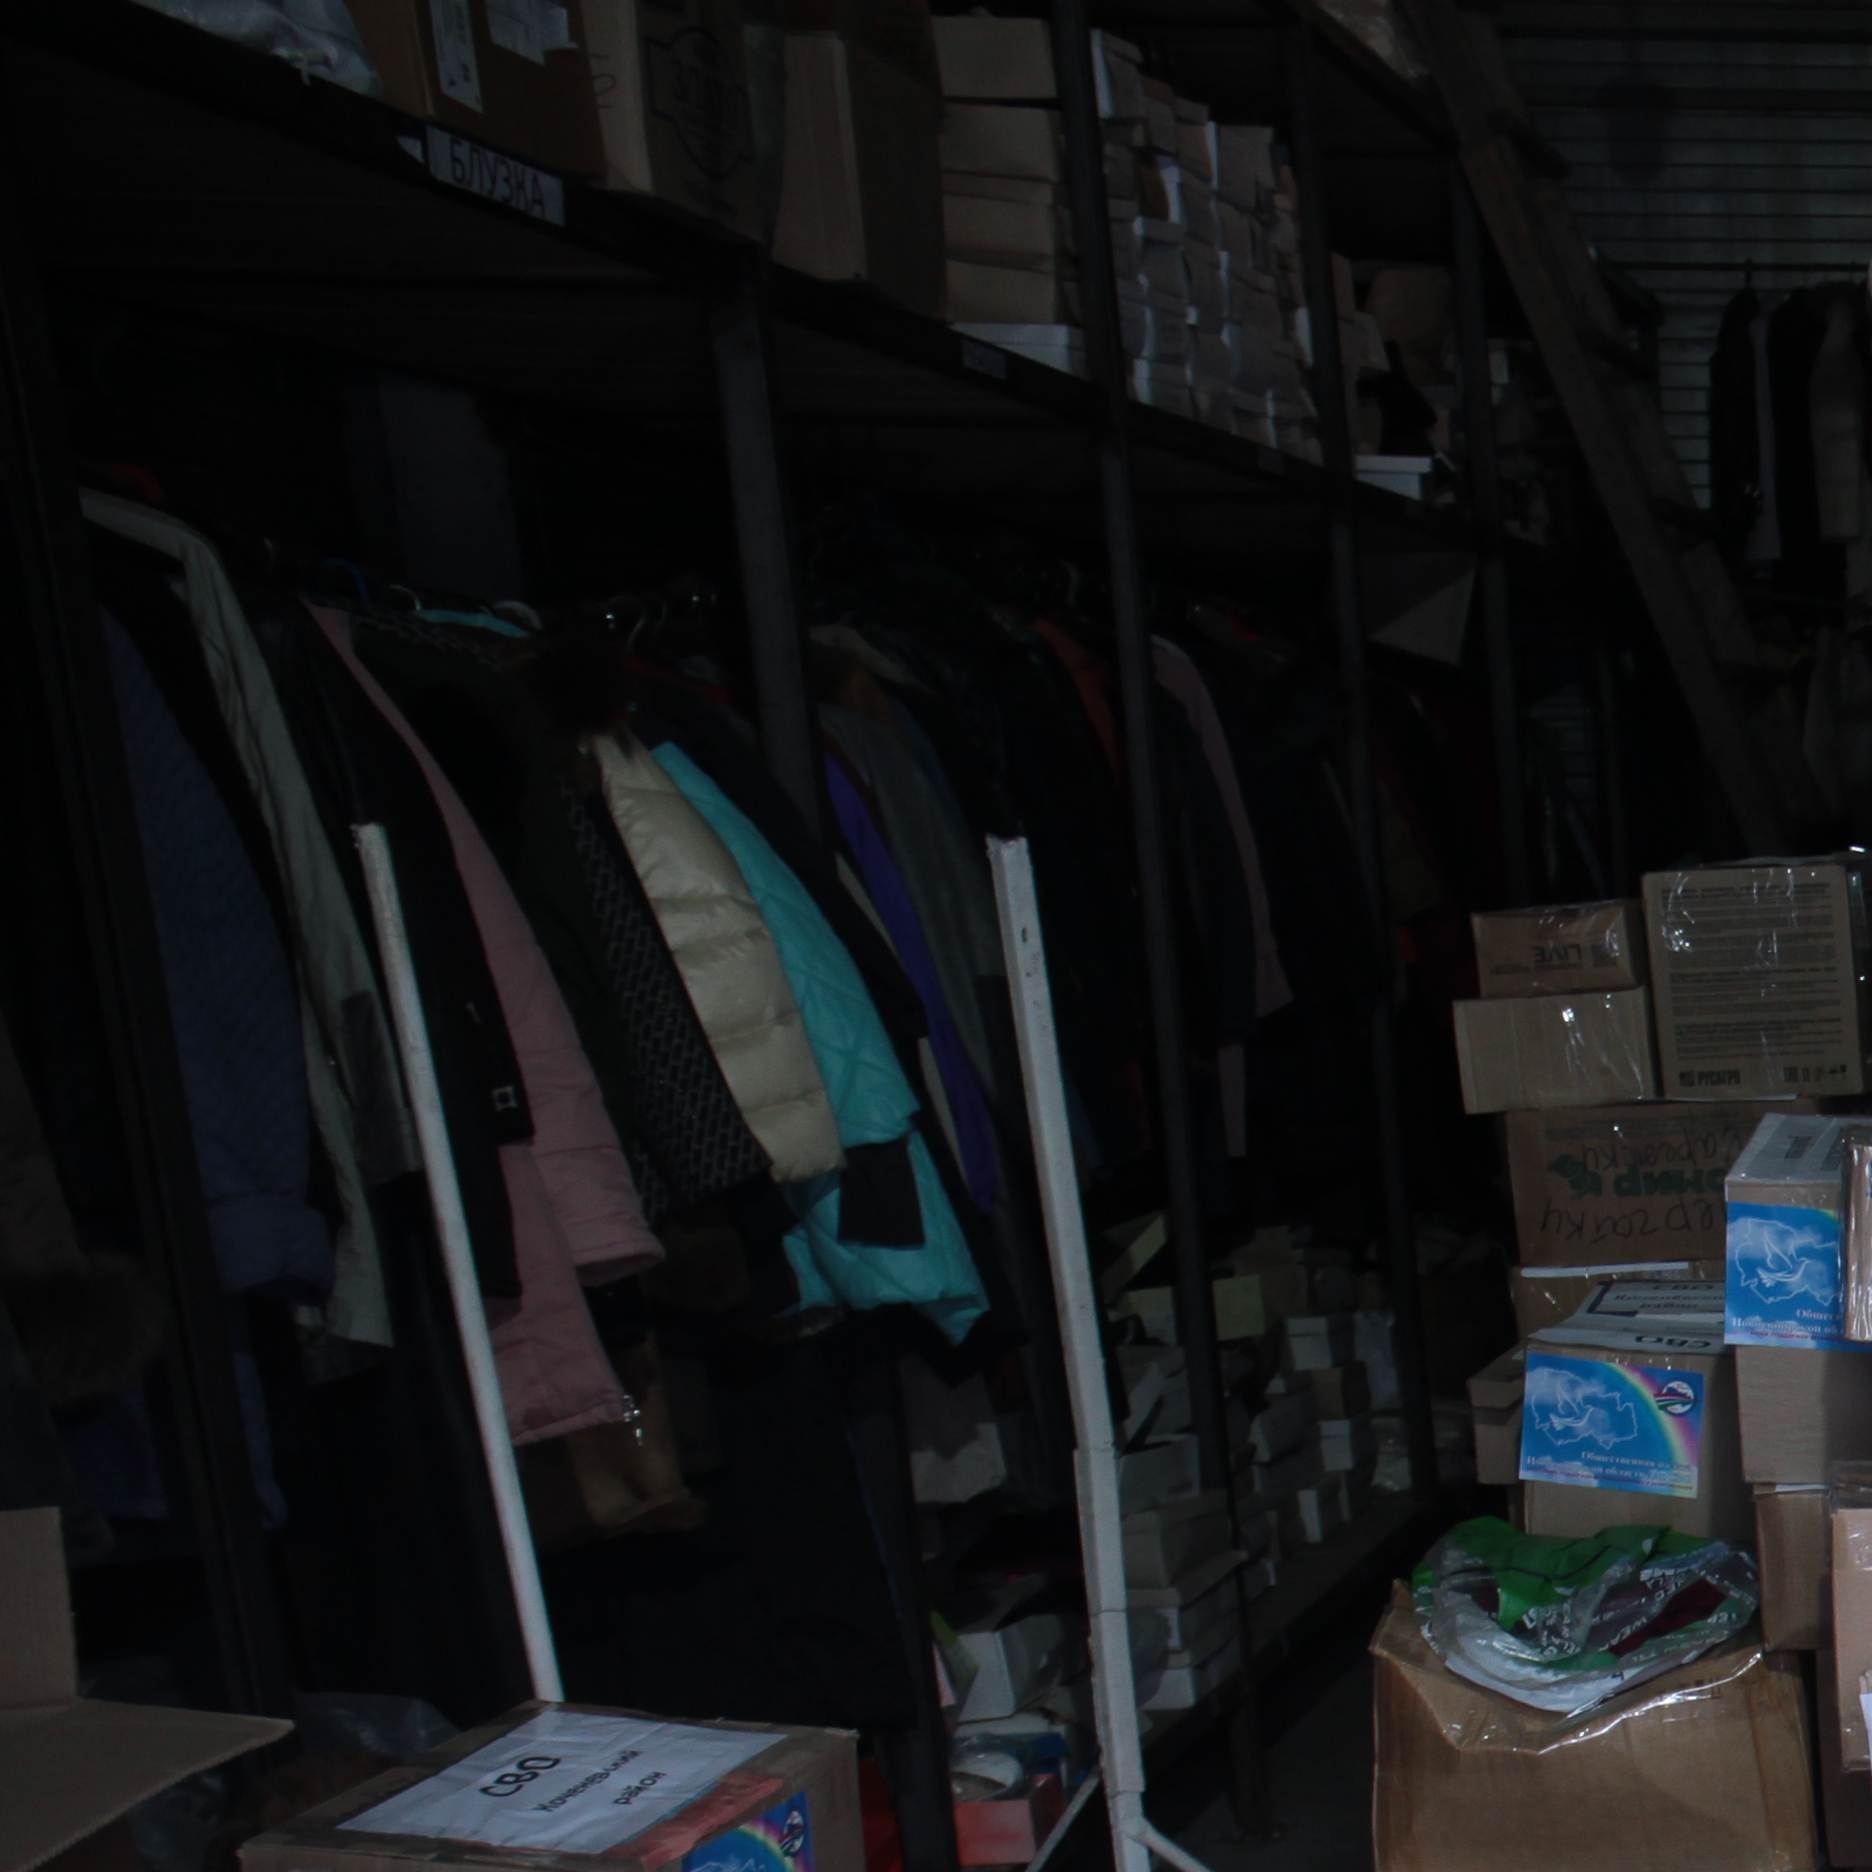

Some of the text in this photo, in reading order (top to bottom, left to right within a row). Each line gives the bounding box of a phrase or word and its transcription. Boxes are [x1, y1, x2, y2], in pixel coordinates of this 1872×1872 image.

[450, 137, 545, 220] БЛУЗКА
[1697, 1070, 1741, 1087] РУСАГРО
[1540, 1196, 1725, 1243] ерчатки
[478, 1756, 562, 1798] СВО
[612, 1771, 667, 1806] район
